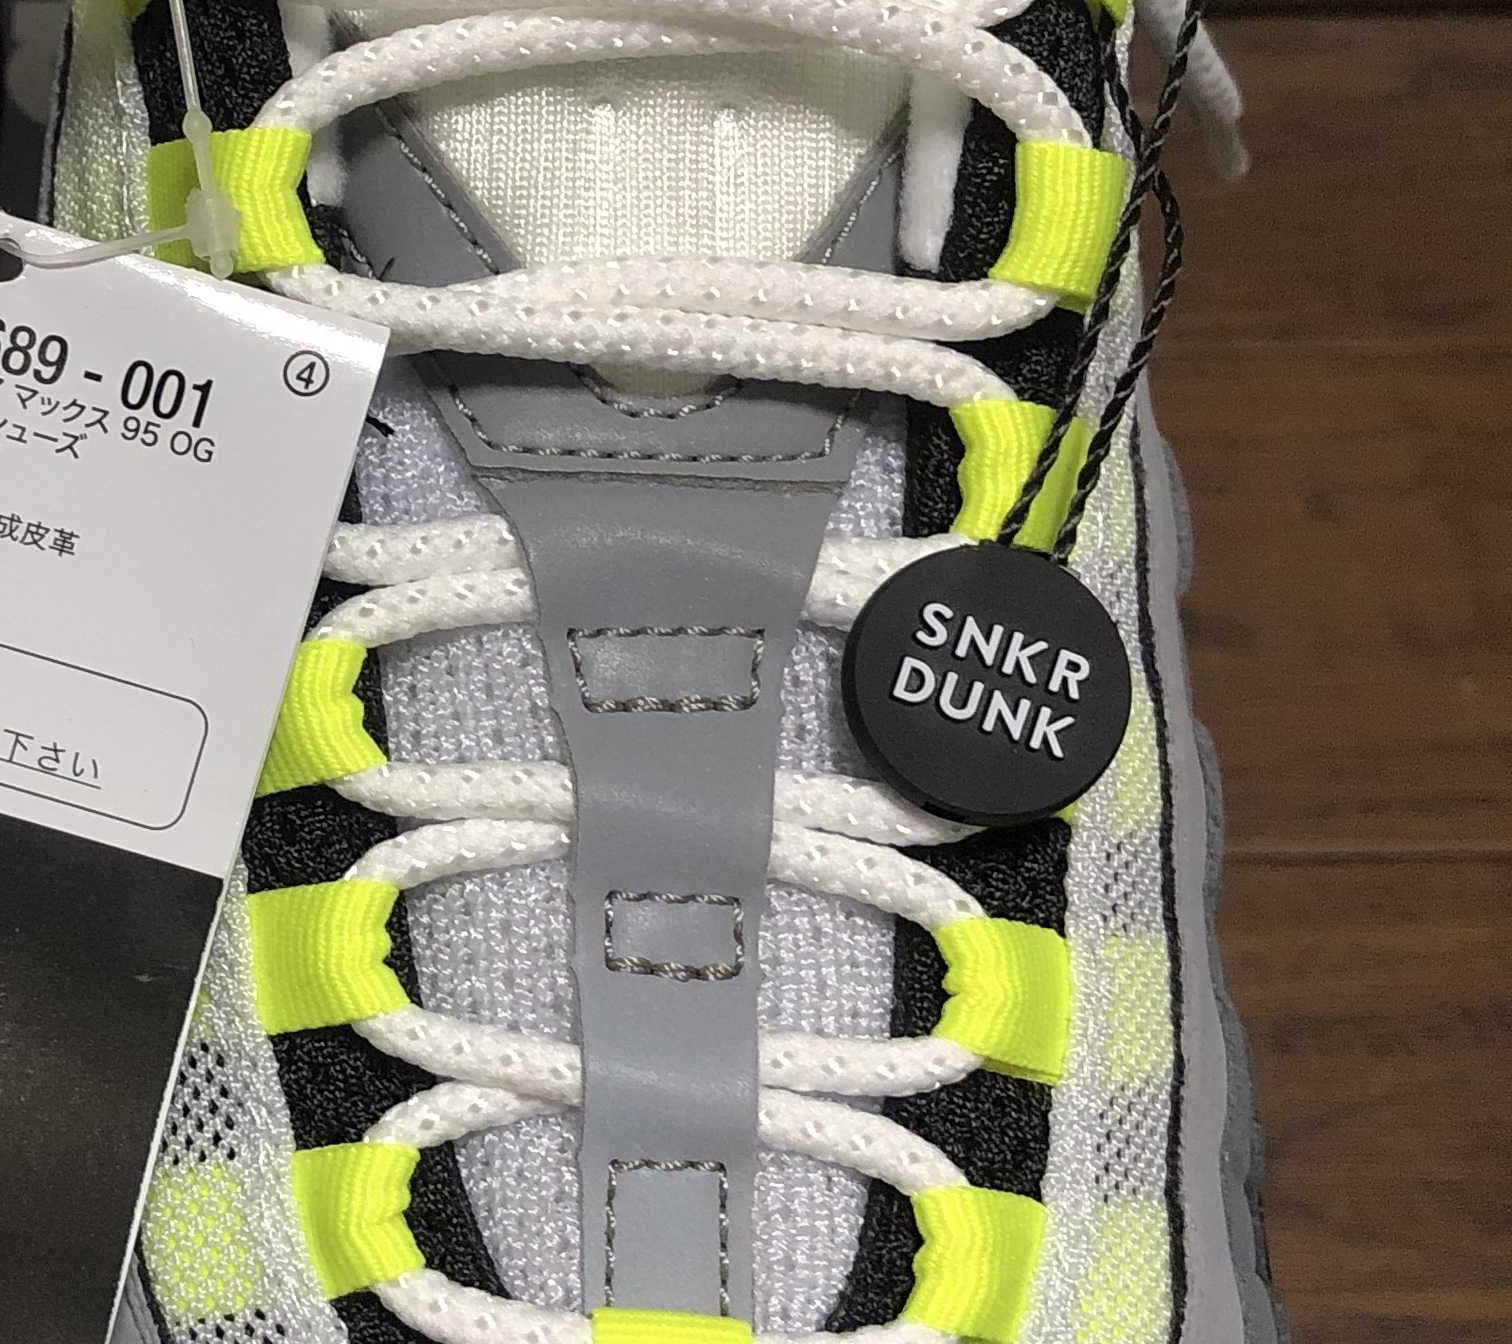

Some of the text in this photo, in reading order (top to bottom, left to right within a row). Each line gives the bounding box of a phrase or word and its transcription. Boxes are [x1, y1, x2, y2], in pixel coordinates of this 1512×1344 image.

[120, 416, 162, 447] 95
[169, 431, 216, 463] OG
[915, 602, 1091, 702] SNKR
[892, 655, 1076, 760] DUNK
